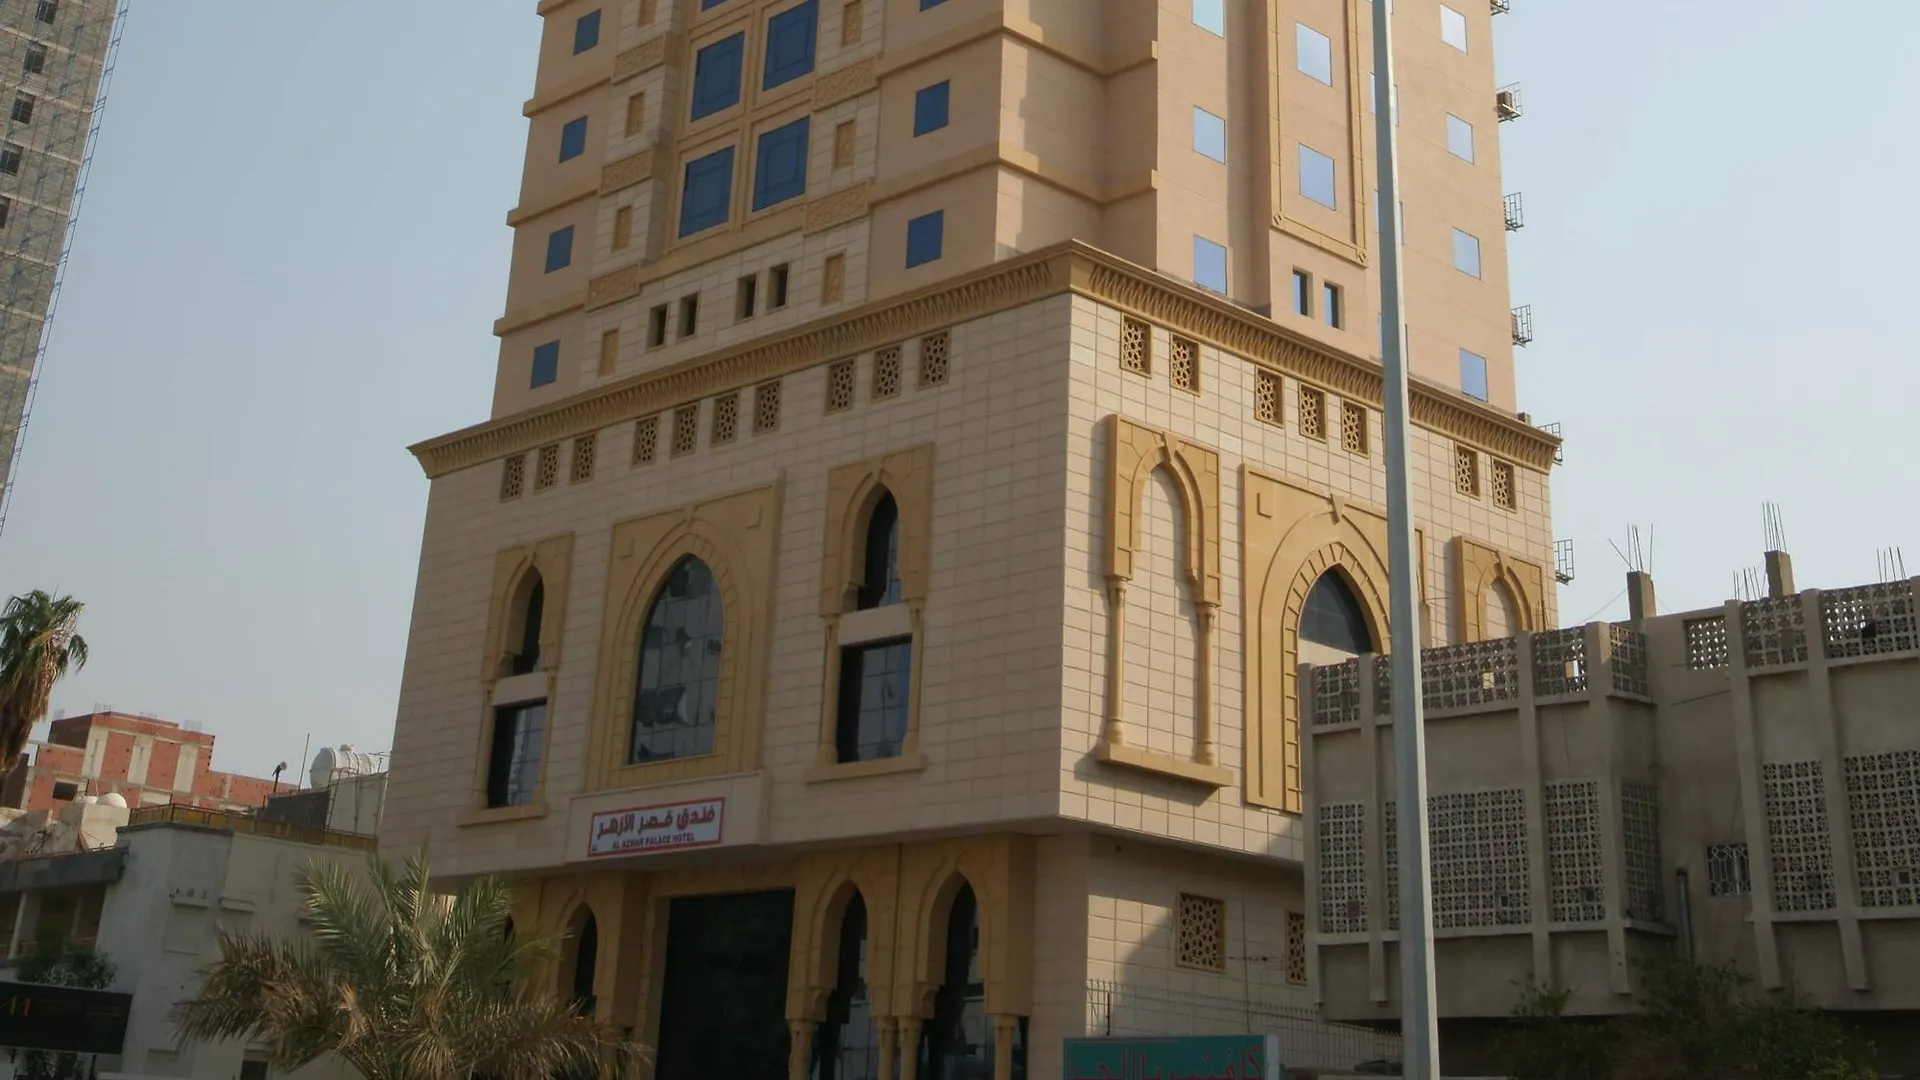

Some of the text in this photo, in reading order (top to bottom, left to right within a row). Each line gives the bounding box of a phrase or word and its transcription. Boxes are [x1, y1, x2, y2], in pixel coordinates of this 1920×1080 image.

[638, 809, 673, 834] قصر
[676, 805, 716, 830] فندق
[612, 832, 695, 849] AL AZHAR PALACE HOTEL
